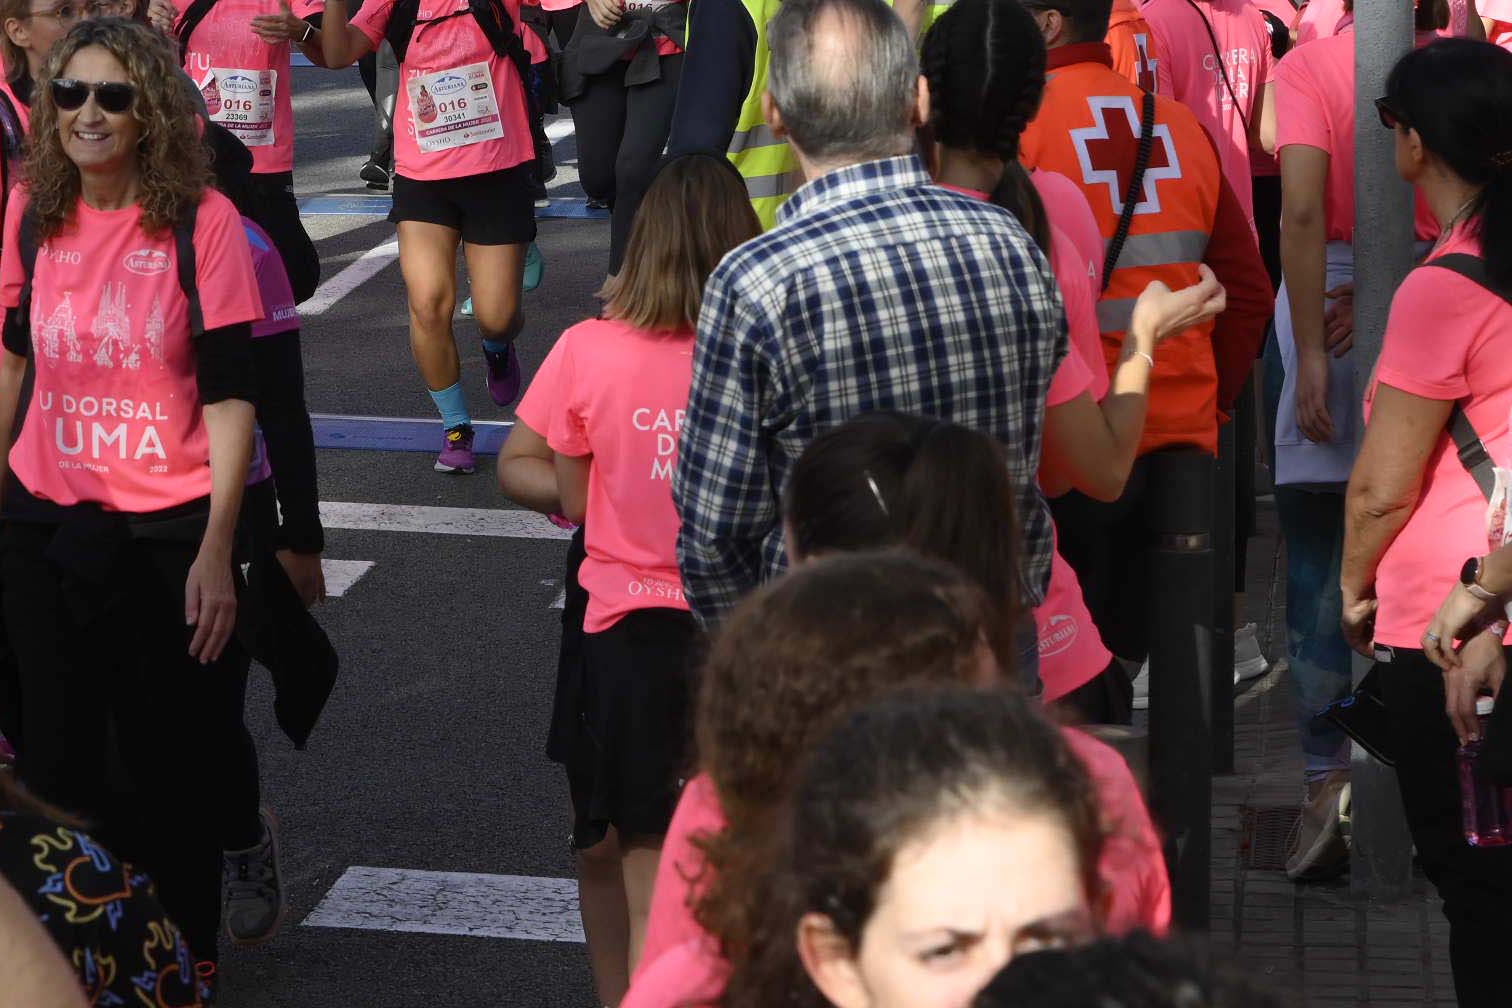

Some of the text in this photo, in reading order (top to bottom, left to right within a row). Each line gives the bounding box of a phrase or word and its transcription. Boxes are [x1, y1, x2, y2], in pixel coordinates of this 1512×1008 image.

[223, 99, 252, 111] 016
[438, 98, 467, 113] 016
[443, 112, 466, 123] 30341
[62, 396, 169, 421] DORSAL
[55, 417, 167, 460] UMA
